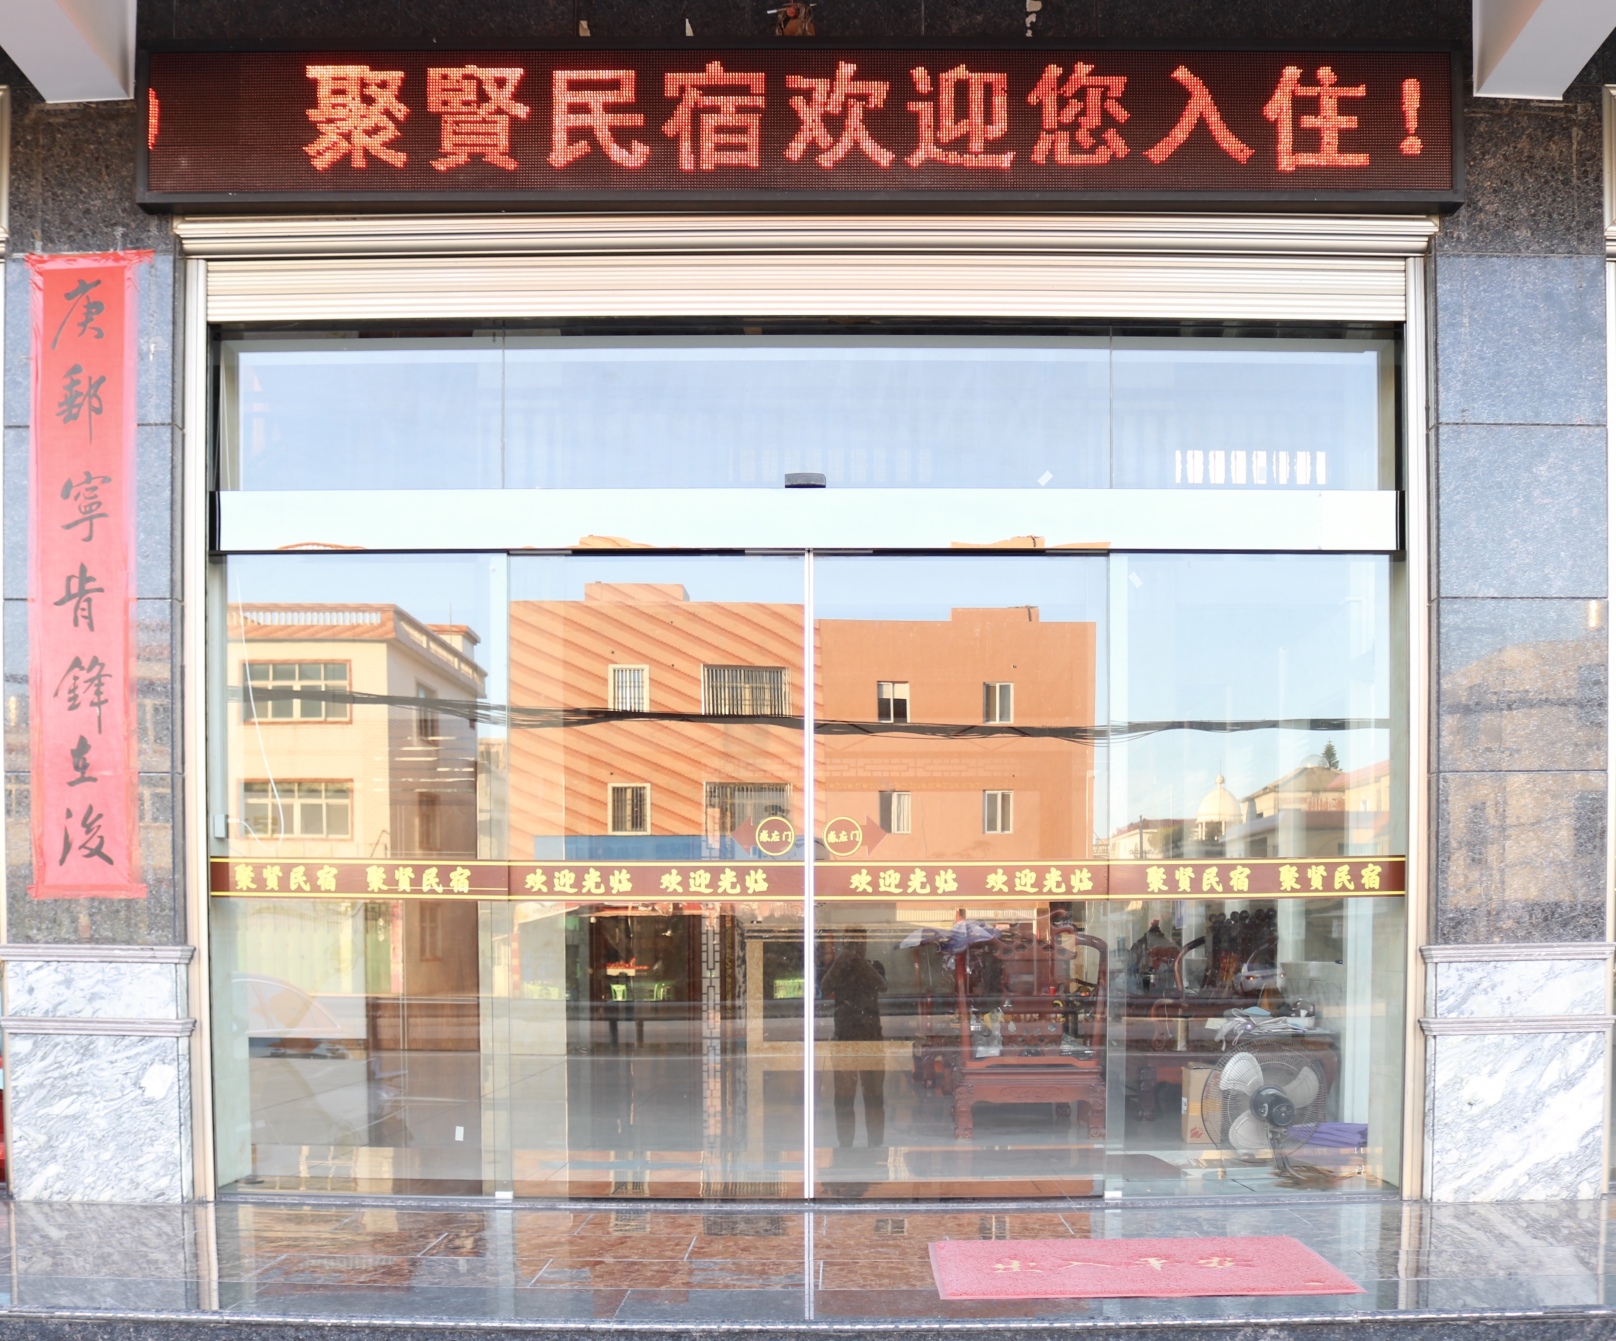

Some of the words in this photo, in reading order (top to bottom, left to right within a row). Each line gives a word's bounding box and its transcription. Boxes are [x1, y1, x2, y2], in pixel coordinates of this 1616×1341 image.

[234, 865, 339, 892] 聚贤民宿
[365, 865, 472, 893] 聚贤民宿
[524, 867, 634, 894] 欢迎光临
[659, 868, 769, 894] 欢迎光临
[849, 867, 959, 894] 欢迎光临
[985, 866, 1094, 894] 欢迎光临
[1145, 865, 1251, 892] 聚贤民宿
[1278, 864, 1382, 891] 聚贤民宿
